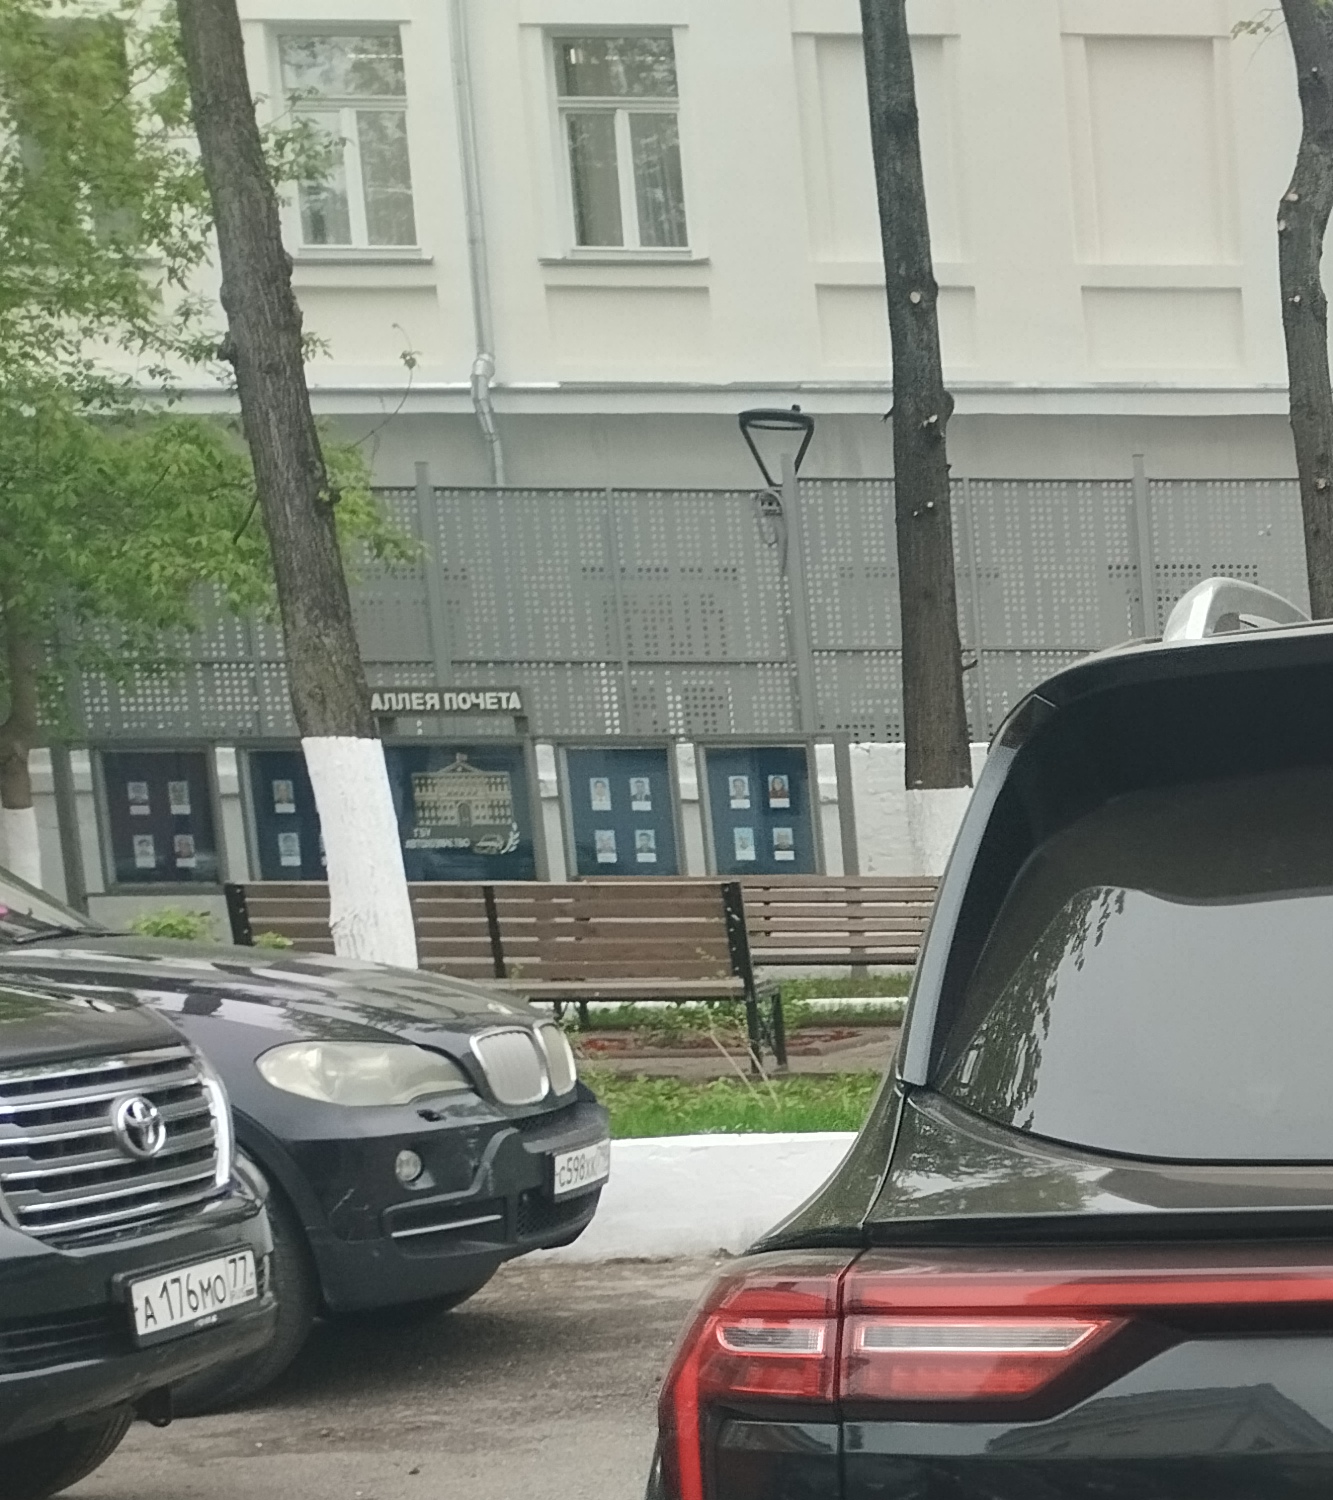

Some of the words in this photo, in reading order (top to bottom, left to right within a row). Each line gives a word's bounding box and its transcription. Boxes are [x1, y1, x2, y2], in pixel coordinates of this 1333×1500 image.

[371, 692, 440, 711] АЛЛЕЯ
[444, 691, 522, 710] ПОЧЕТА
[228, 1255, 247, 1288] 77
